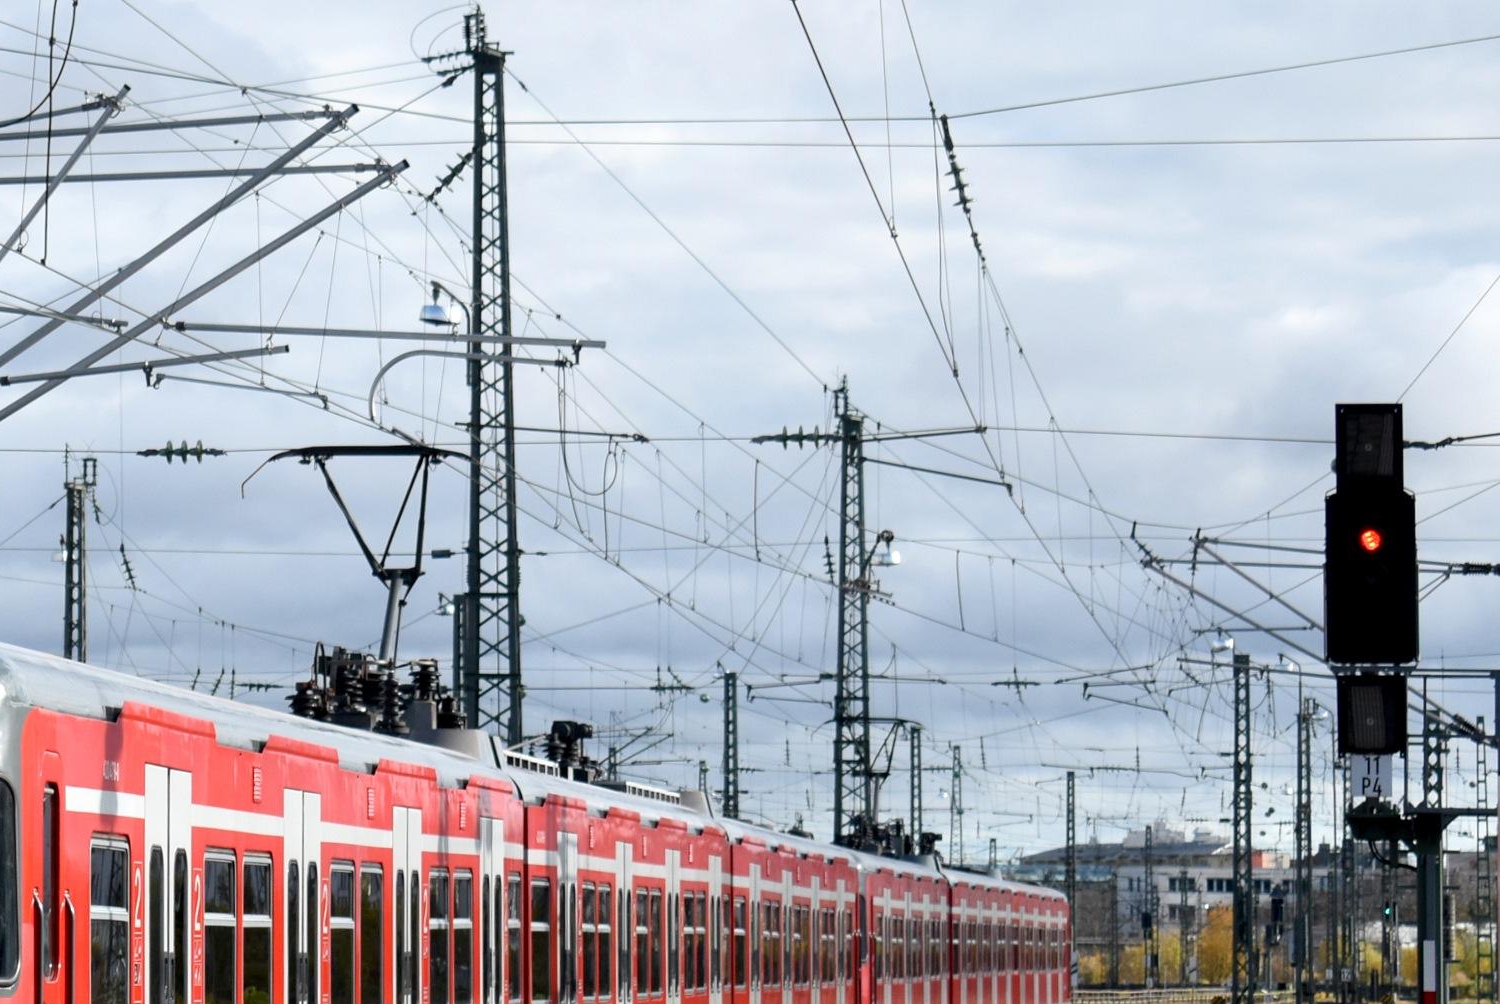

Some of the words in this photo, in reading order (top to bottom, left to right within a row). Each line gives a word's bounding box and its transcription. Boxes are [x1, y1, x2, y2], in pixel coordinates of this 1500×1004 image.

[1364, 756, 1380, 775] 11
[1362, 777, 1382, 797] P4
[134, 867, 142, 929] 2
[194, 874, 201, 931] 2
